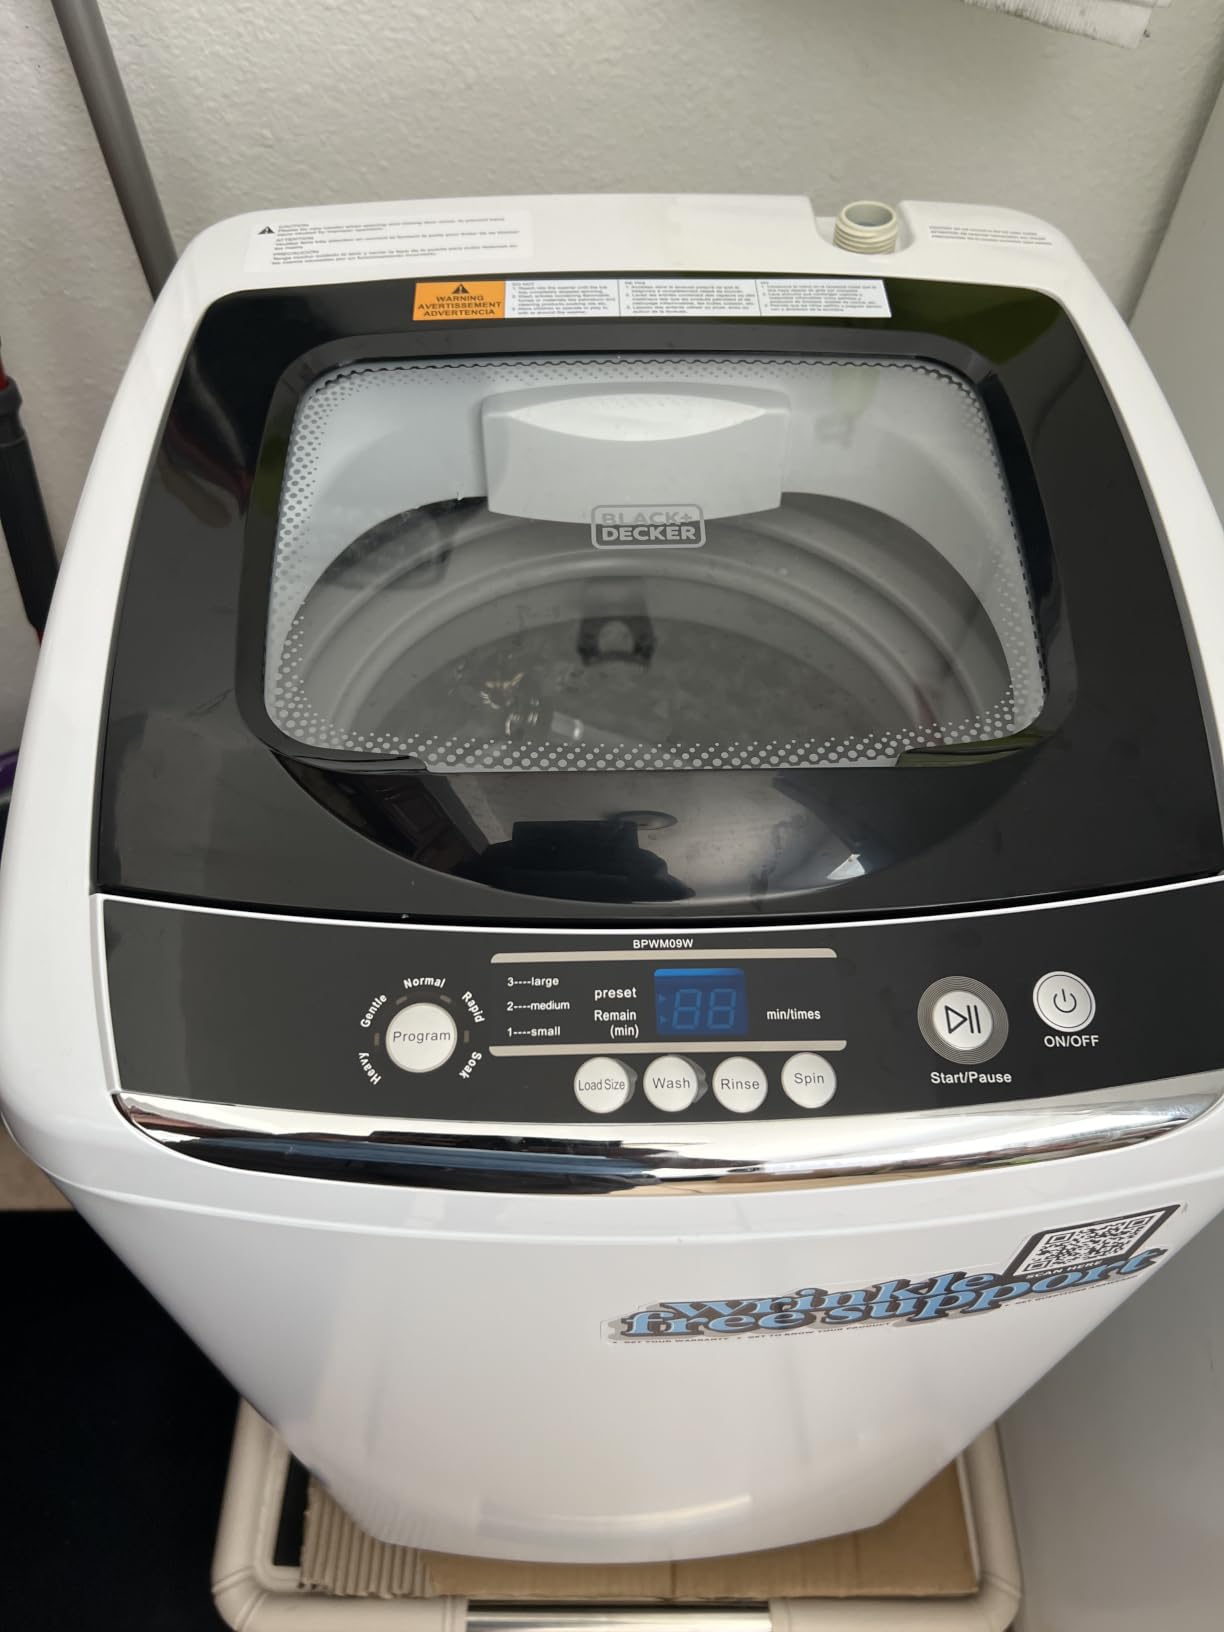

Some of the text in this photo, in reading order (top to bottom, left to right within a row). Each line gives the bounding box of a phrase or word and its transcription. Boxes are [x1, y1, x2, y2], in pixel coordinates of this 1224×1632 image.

[418, 301, 502, 310] AVERTISSEMENT
[424, 309, 496, 317] ADVERTENCIA
[601, 511, 693, 525] BLACK+
[602, 526, 697, 541] DECKER
[633, 939, 694, 949] BPWM09W
[403, 977, 446, 989] Normal
[594, 985, 637, 1001] preset
[360, 994, 388, 1028] Gentle
[461, 991, 485, 1023] Rapid
[594, 1010, 637, 1021] Remain
[767, 1008, 821, 1020] min/times
[392, 1030, 452, 1044] Program
[610, 1025, 639, 1039] (min)
[1044, 1035, 1100, 1048] ON/OFF
[358, 1052, 382, 1085] Heavy
[459, 1051, 482, 1079] Soak
[652, 1077, 691, 1089] Wash
[720, 1078, 760, 1090] Rinse
[793, 1072, 825, 1086] Spin
[930, 1071, 1012, 1084] Start/Pause
[578, 1079, 626, 1091] Load Size
[1026, 1268, 1063, 1280] SCAN
[621, 1309, 816, 1337] free
[820, 1247, 1169, 1324] support
[660, 1270, 1000, 1318] wrinkle
